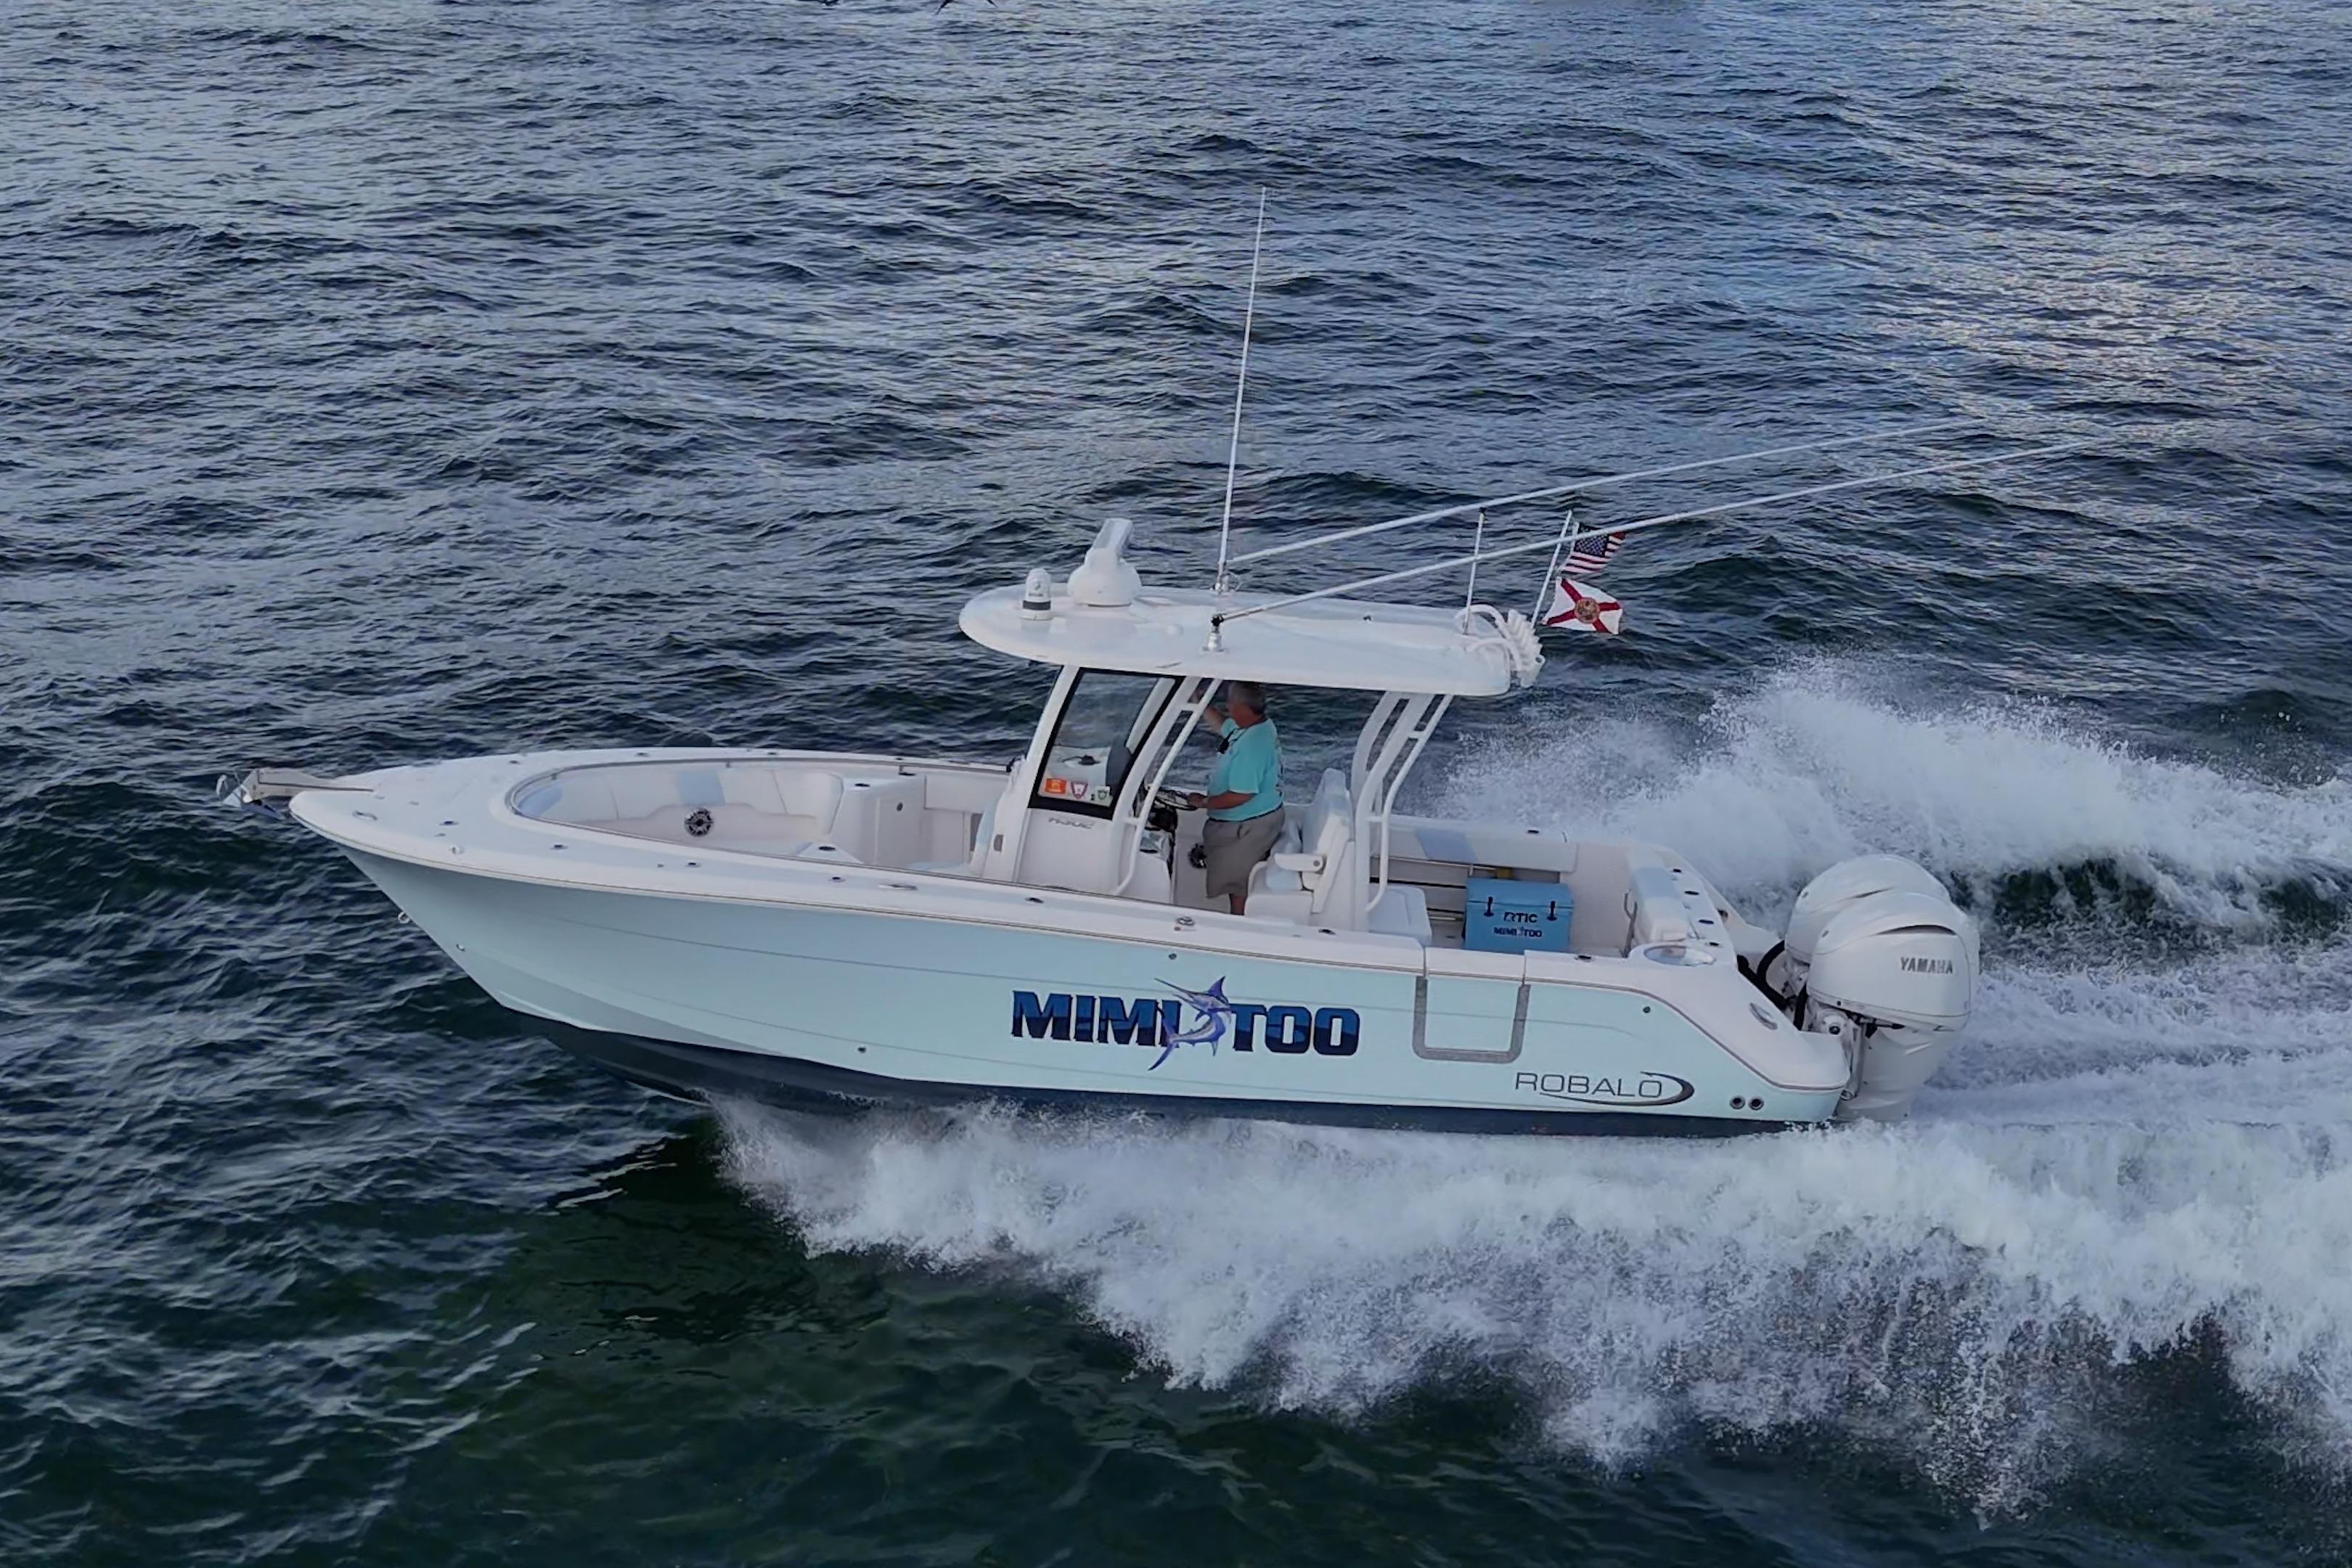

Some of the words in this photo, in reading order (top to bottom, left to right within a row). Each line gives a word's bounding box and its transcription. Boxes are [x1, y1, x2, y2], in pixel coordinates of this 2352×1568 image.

[1503, 912, 1538, 923] RTIC
[1900, 956, 1953, 974] YAMAHA
[1011, 990, 1182, 1048] MIMI
[1229, 1003, 1360, 1056] TOO
[1515, 1071, 1662, 1098] ROBALO
